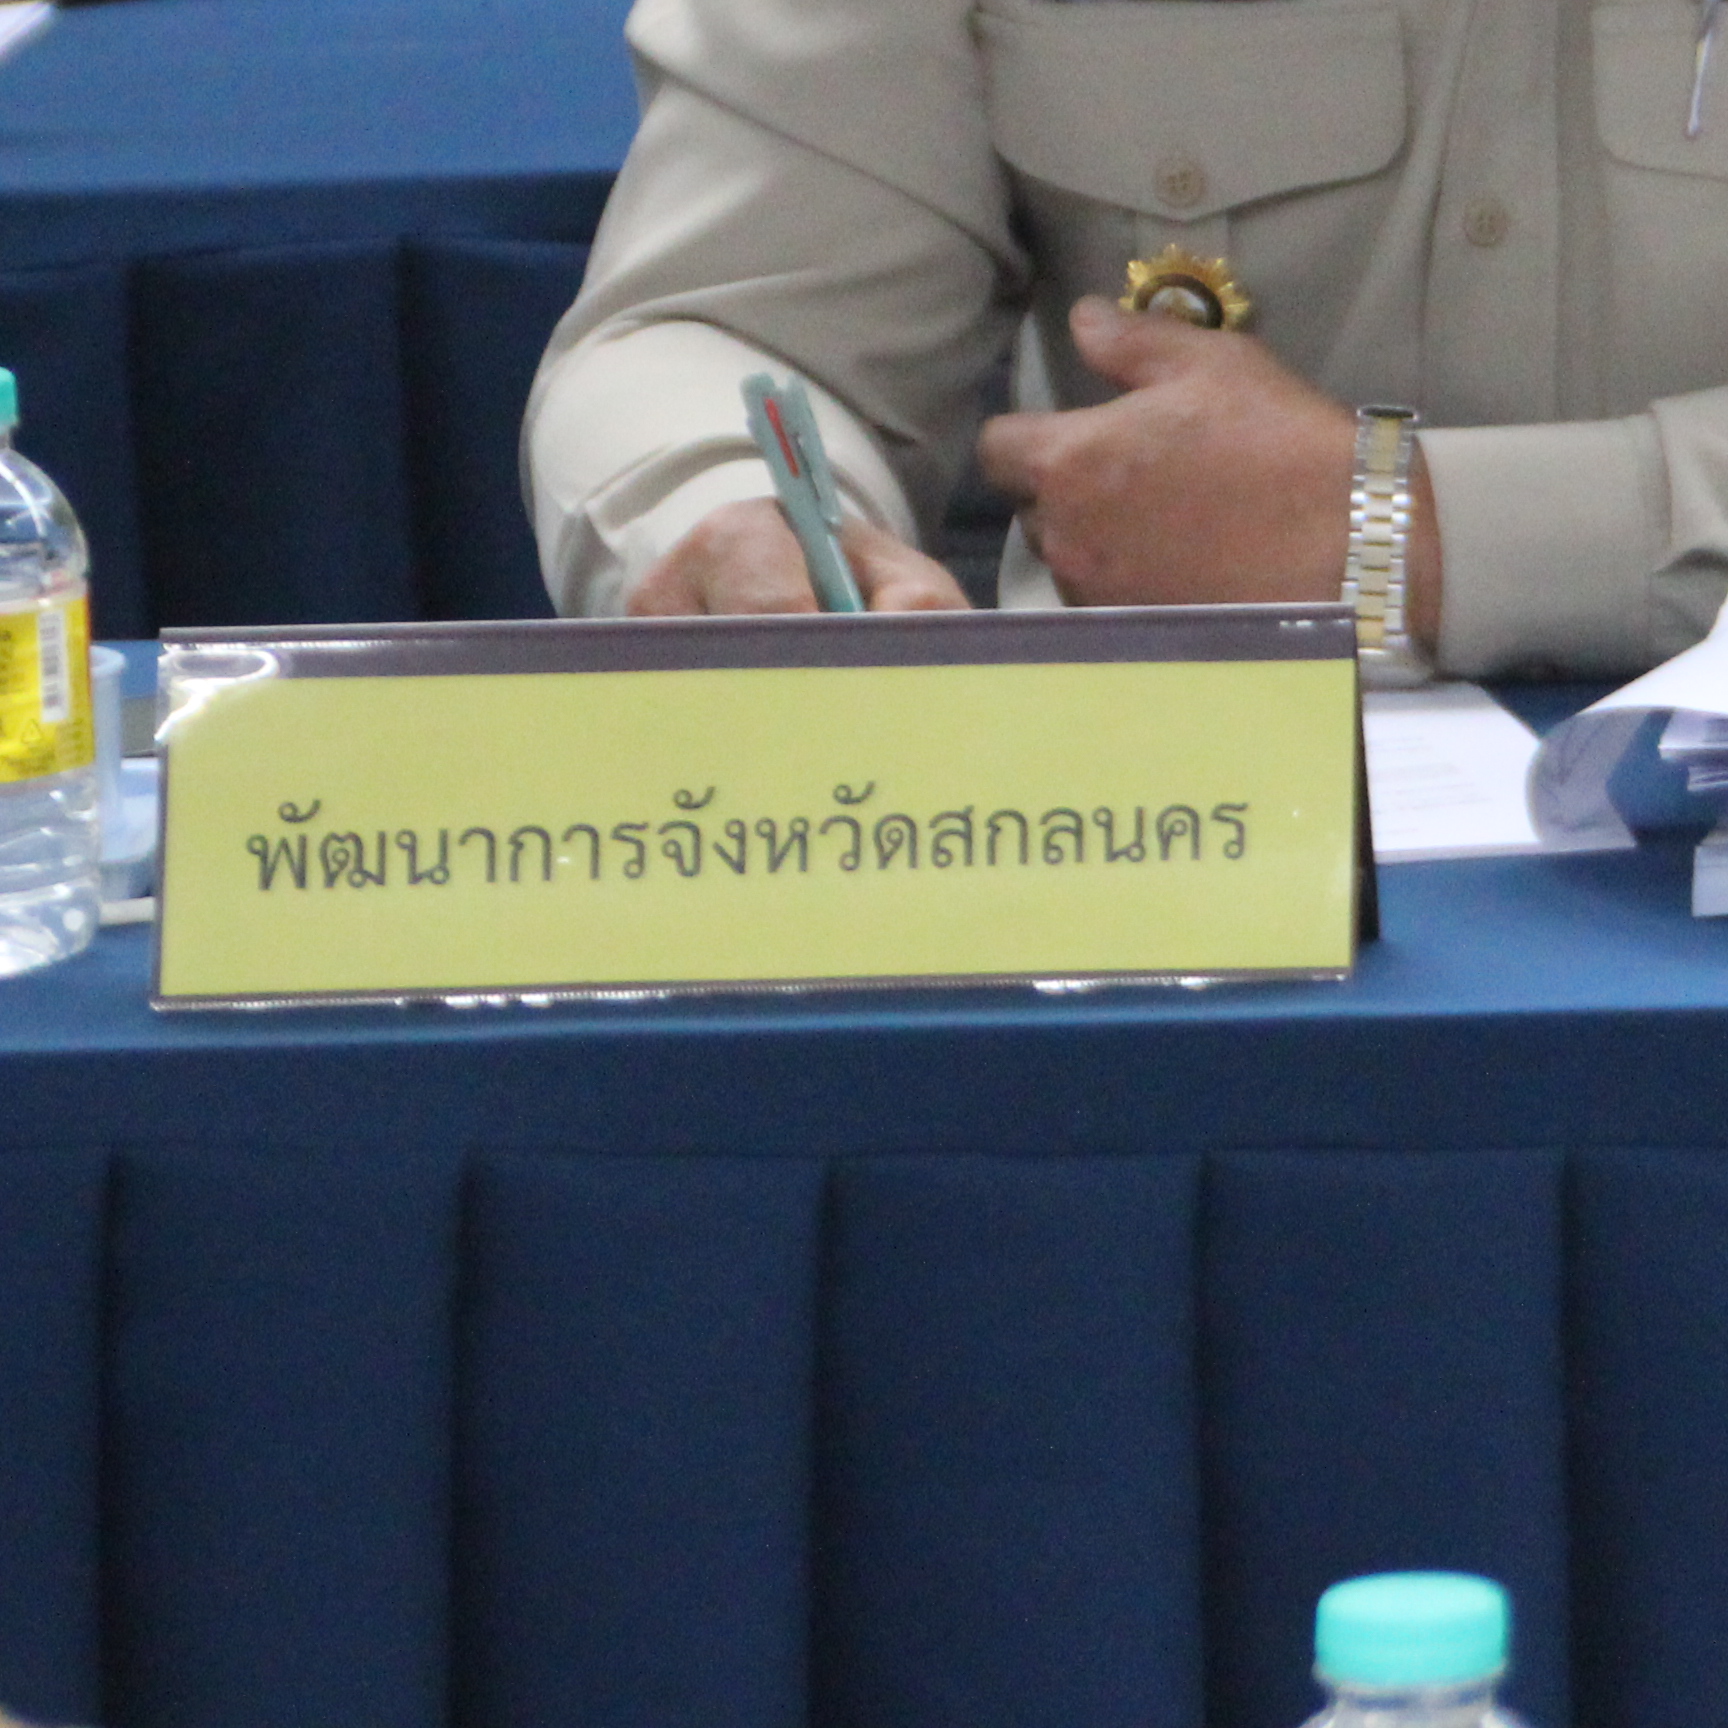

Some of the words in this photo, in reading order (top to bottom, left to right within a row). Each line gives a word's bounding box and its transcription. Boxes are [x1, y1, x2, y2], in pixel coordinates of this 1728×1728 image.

[244, 780, 1253, 894] พัฒนาการจังหวัดสกลนคร
